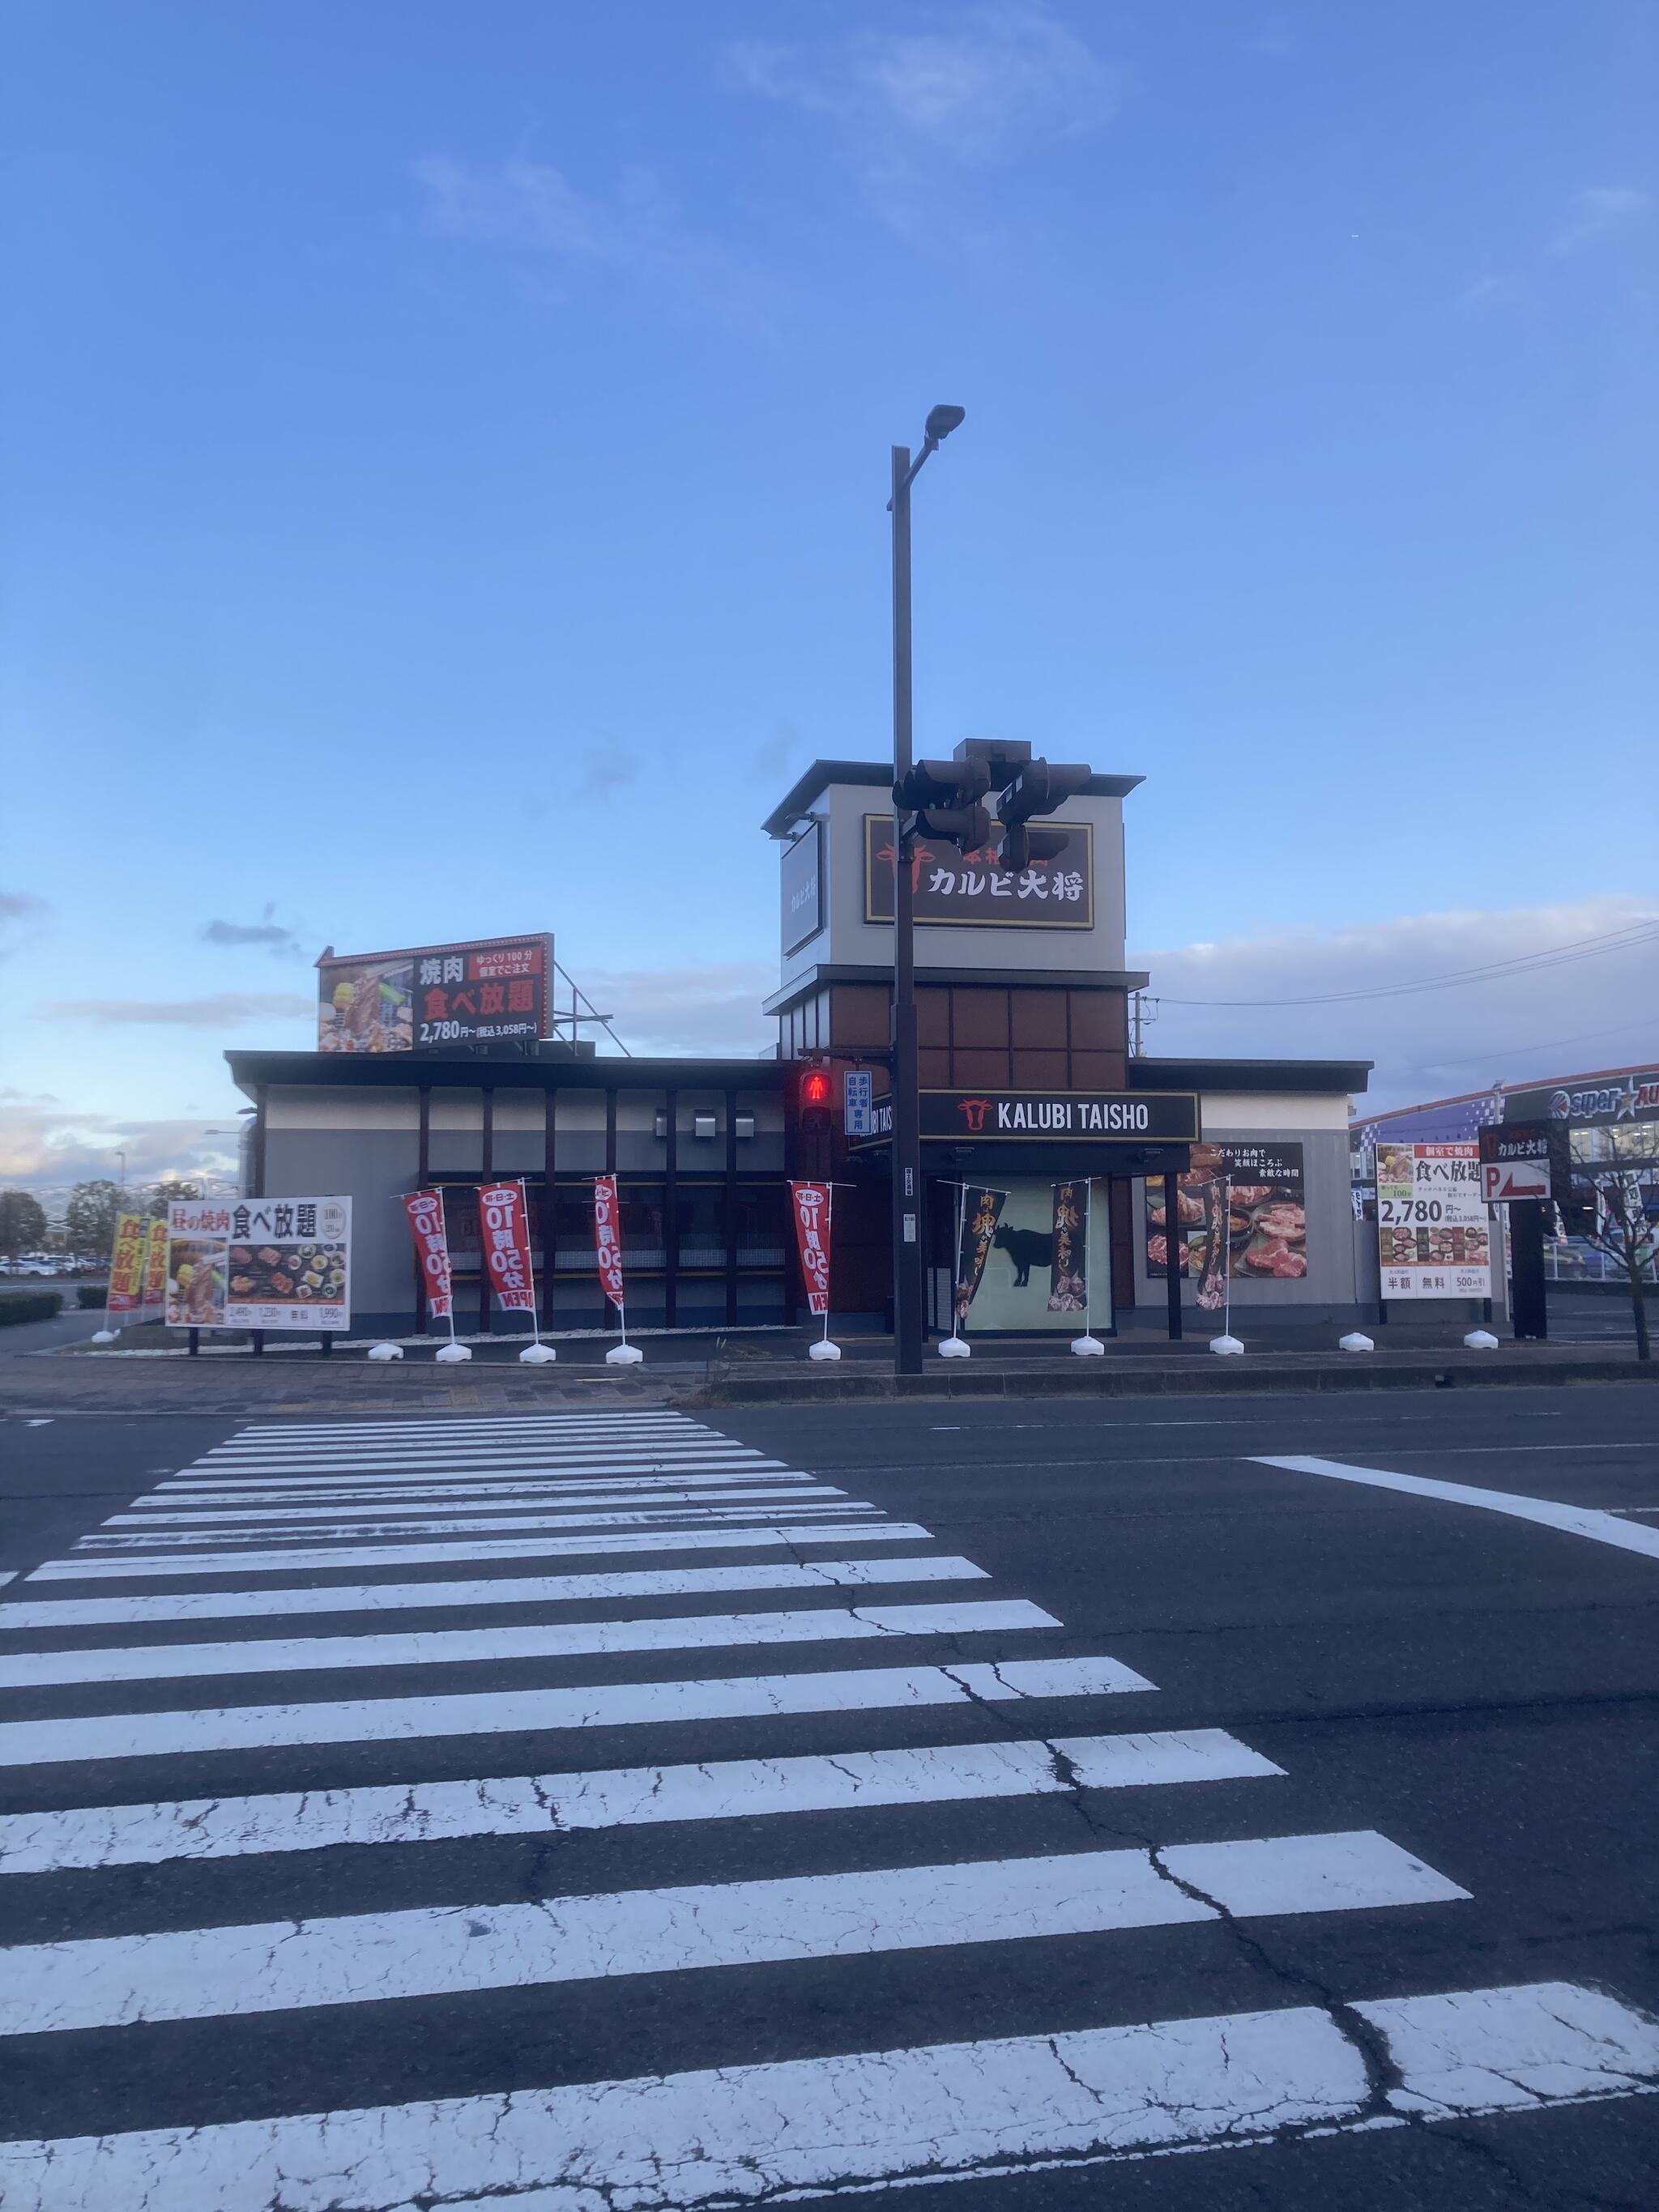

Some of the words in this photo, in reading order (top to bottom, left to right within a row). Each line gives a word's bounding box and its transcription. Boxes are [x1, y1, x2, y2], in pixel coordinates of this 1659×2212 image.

[928, 868, 1084, 901] カルビ大将
[420, 956, 464, 986] 焼肉
[424, 979, 535, 1021] 食べ放題
[848, 1077, 858, 1107] 自転車
[859, 1076, 868, 1107] 歩行者
[854, 1110, 863, 1130] 専用
[998, 1102, 1071, 1128] KALUBI
[1077, 1104, 1149, 1130] TAISHO
[1209, 1149, 1266, 1158] こだわりお肉で
[1426, 1146, 1473, 1157] 個室で焼肉
[1498, 1138, 1548, 1157] カルビ大将
[1234, 1158, 1283, 1168] 笑顔ほころぶ
[1258, 1168, 1299, 1178] 素敵な時間
[1416, 1160, 1482, 1183] 食べ放題
[1486, 1167, 1500, 1198] P
[172, 1208, 230, 1232] 昼の焼肉
[232, 1204, 318, 1239] 食べ放題
[1388, 1276, 1411, 1289] 半額
[1422, 1276, 1445, 1289] 無料
